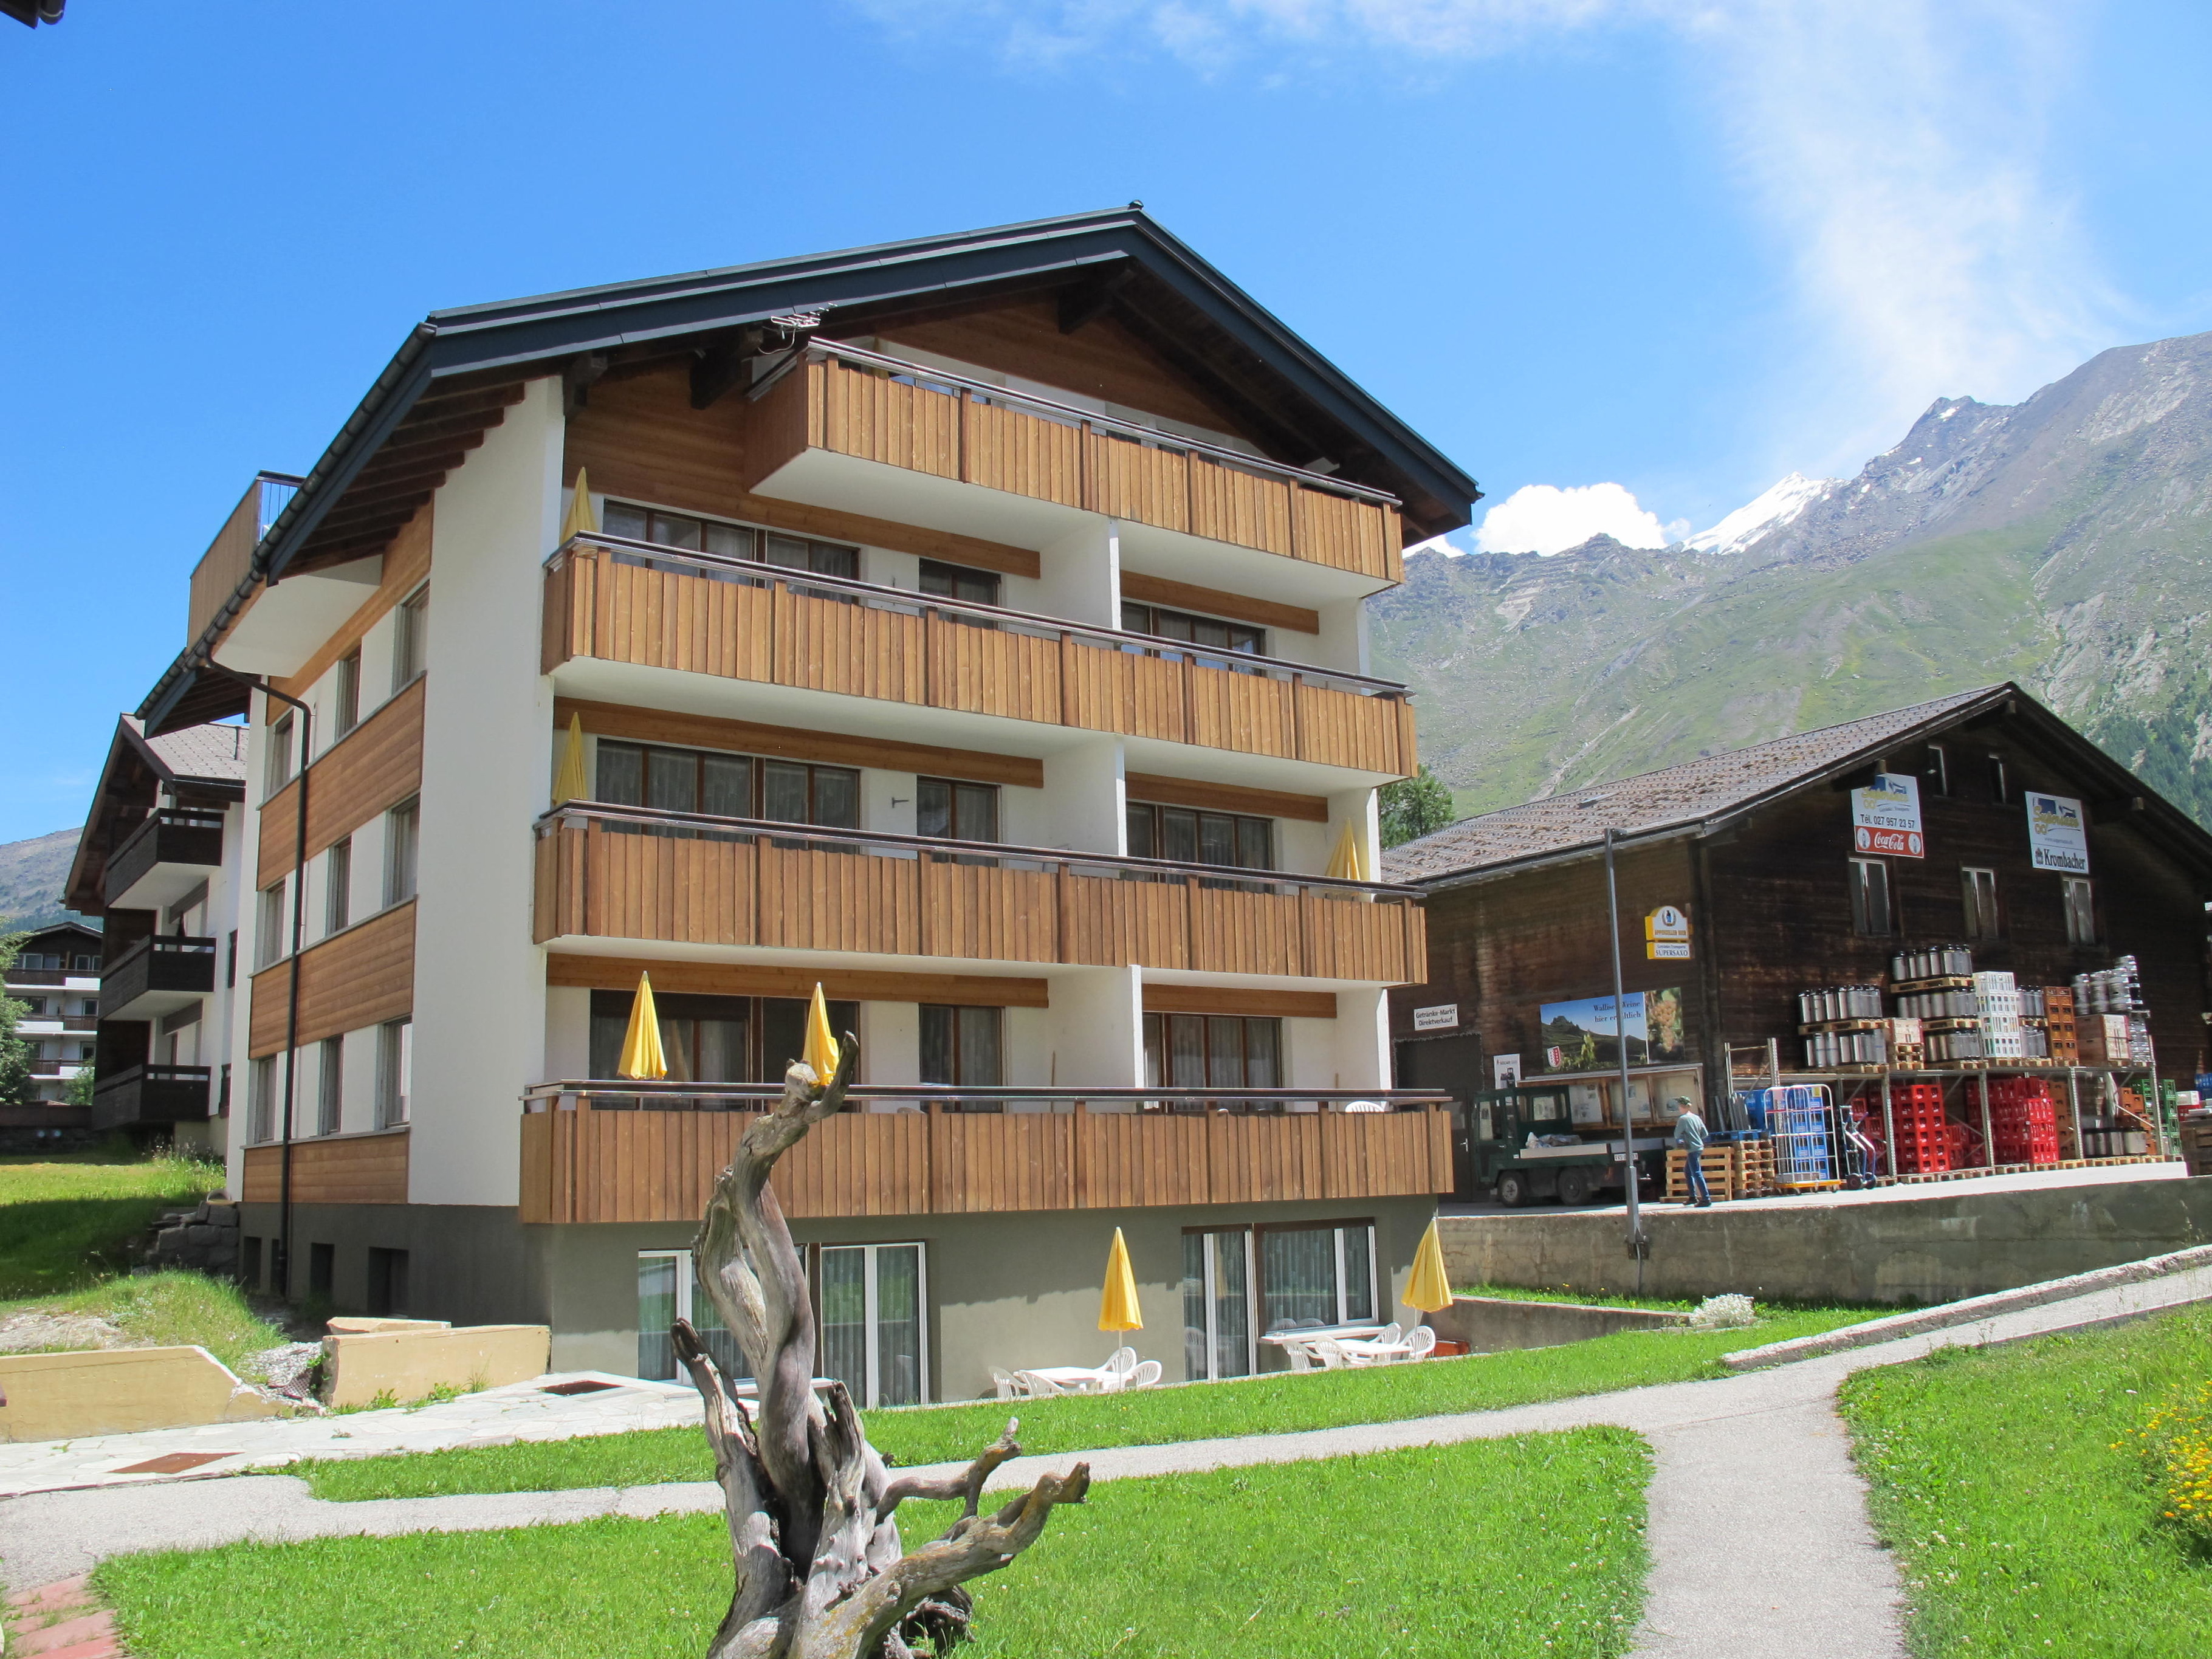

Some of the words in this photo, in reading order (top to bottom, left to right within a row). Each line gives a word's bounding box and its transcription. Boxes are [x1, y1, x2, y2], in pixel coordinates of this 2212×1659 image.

[1874, 816, 1884, 825] 027
[1886, 817, 1897, 826] 957
[1899, 819, 1906, 828] 23
[1908, 820, 1915, 828] 57
[2044, 848, 2085, 870] Krombacher
[1418, 1015, 1452, 1026] Direktverkauf
